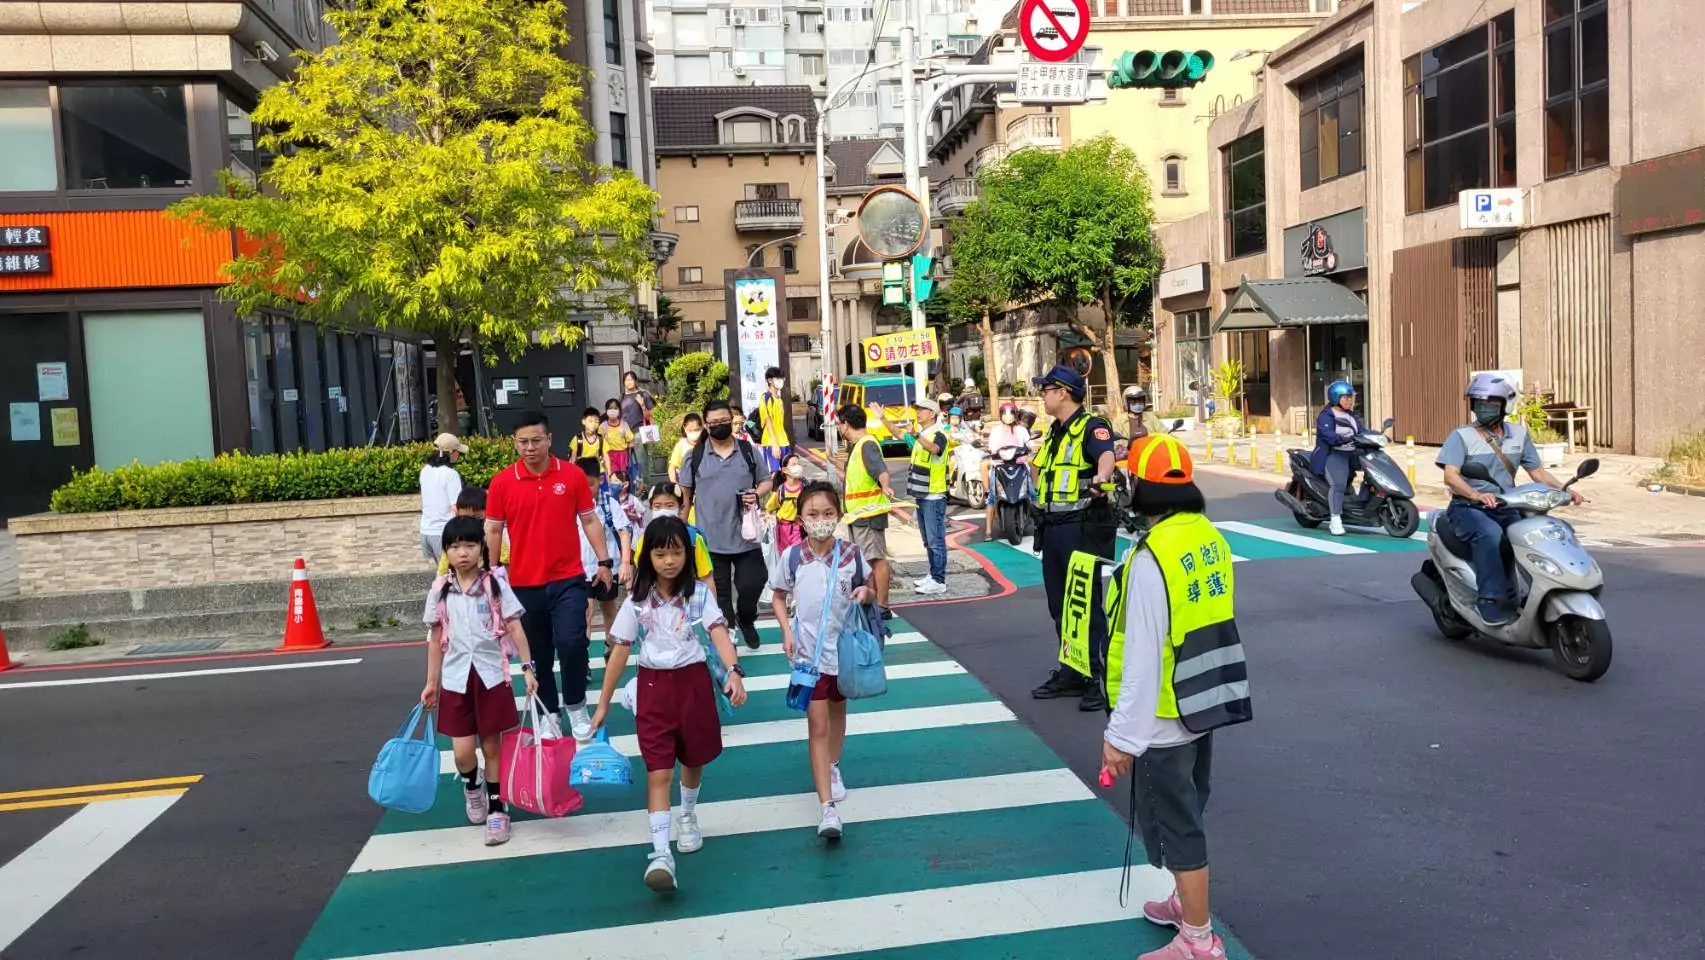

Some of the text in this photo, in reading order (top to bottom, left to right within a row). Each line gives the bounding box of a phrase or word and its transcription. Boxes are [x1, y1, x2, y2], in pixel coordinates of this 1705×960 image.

[1478, 196, 1489, 211] P
[5, 227, 42, 244] 輕食
[0, 255, 40, 270] 維修
[885, 341, 933, 361] 請勿左轉
[1187, 571, 1228, 603] 導護
[1065, 562, 1090, 640] 停
